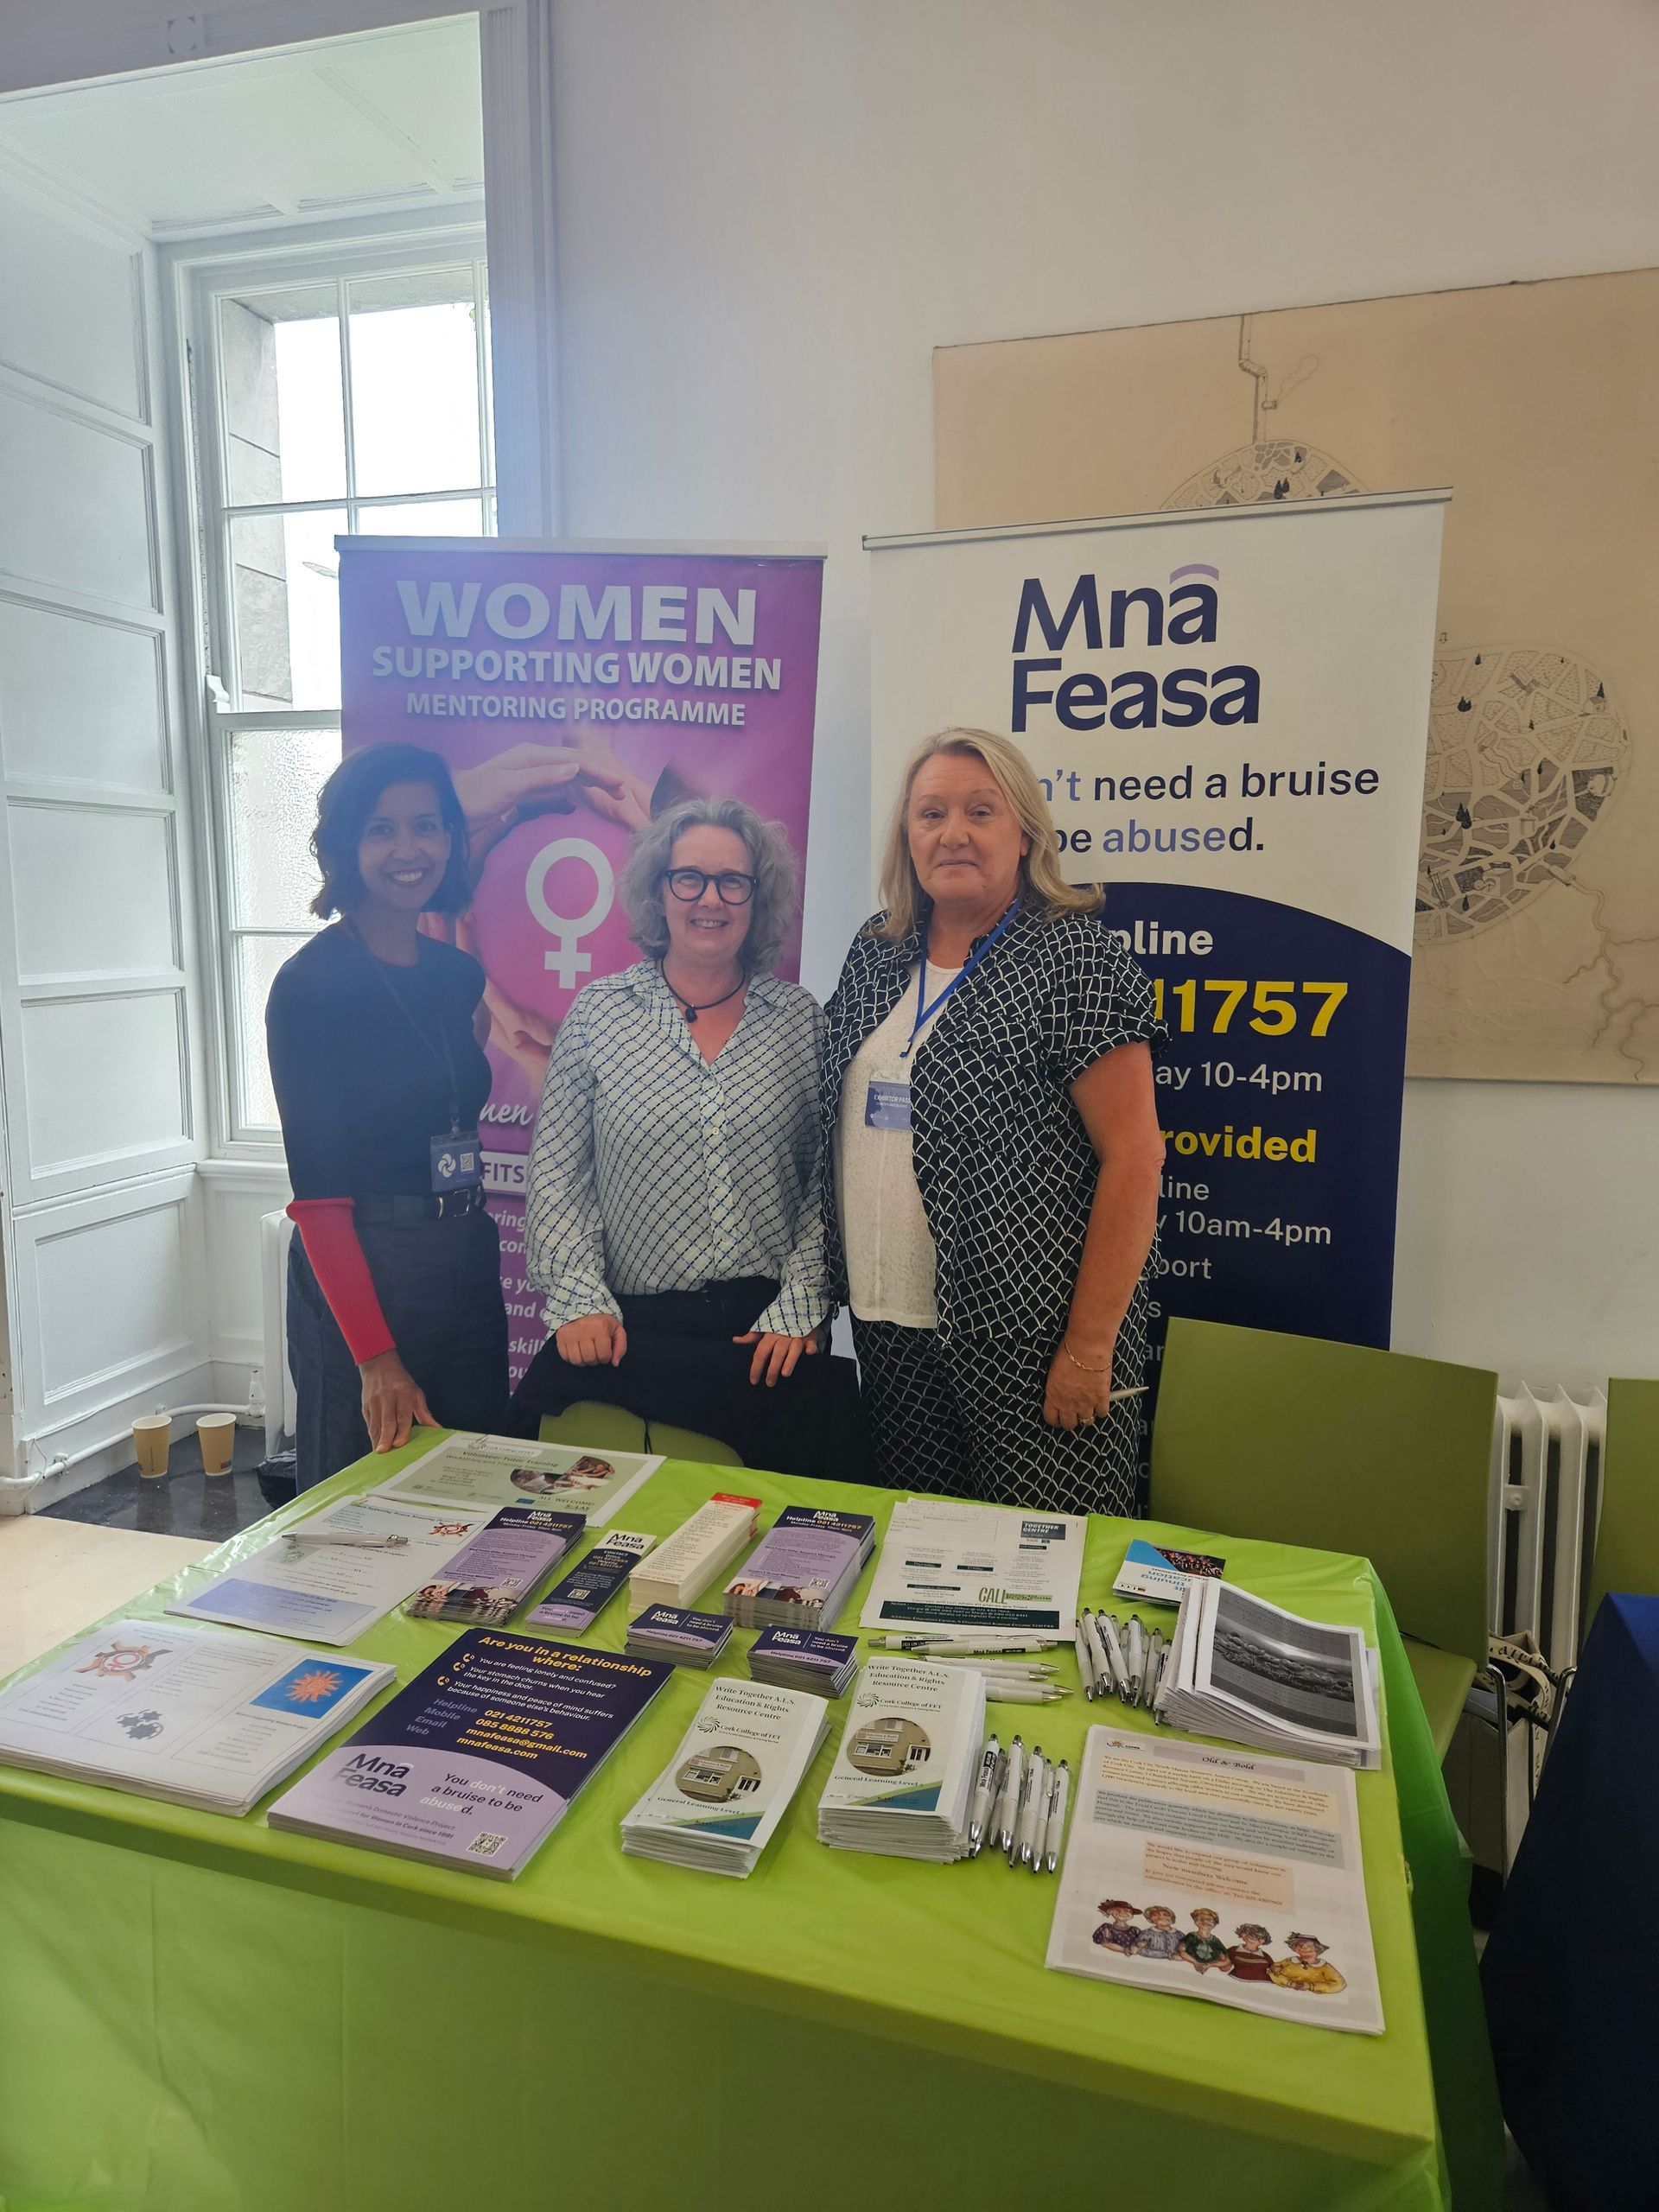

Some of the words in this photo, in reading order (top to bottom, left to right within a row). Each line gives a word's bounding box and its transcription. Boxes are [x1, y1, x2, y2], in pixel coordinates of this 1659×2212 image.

[397, 581, 756, 645] WOMEN
[372, 645, 620, 683] SUPPORTING
[628, 652, 781, 690] WOMEN
[407, 693, 566, 719] MENTORING
[574, 698, 745, 726] PROGRAMME
[1011, 658, 1260, 733] Feasa
[1095, 766, 1192, 800] need
[1205, 772, 1226, 798] a
[1242, 761, 1379, 798] bruise
[1103, 817, 1263, 852] abused.
[1109, 920, 1213, 956] pline
[1154, 978, 1348, 1037] 11757
[1201, 1062, 1322, 1095] 10-4pm
[1160, 1125, 1316, 1162] rovided
[482, 1162, 524, 1183] FITS
[1159, 1175, 1210, 1200] line
[1176, 1211, 1332, 1246] 10am-4pm
[979, 1587, 1007, 1604] CALL
[479, 1637, 505, 1647] Are
[505, 1642, 534, 1653] you
[535, 1646, 550, 1656] in
[562, 1653, 652, 1677] relationship
[532, 1656, 582, 1671] where:
[891, 1665, 927, 1675] Together
[487, 1670, 520, 1681] stomach
[520, 1675, 547, 1687] churns
[586, 1690, 606, 1699] hear
[507, 1662, 535, 1674] feeling
[535, 1669, 558, 1678] lonely
[575, 1677, 616, 1689] confused?
[514, 1680, 533, 1690] door.
[448, 1686, 480, 1697] because
[490, 1695, 525, 1707] someone
[549, 1707, 590, 1720] behaviour.
[472, 1684, 512, 1698] happiness
[528, 1697, 552, 1706] peace
[584, 1707, 613, 1719] suffers
[715, 1694, 755, 1707] Education
[764, 1703, 789, 1713] Rights
[739, 1689, 773, 1700] Together
[424, 1707, 461, 1720] Mobile
[475, 1719, 499, 1728] 085
[499, 1723, 531, 1735] 8888
[530, 1730, 554, 1739] 576
[433, 1699, 478, 1713] Helpline
[484, 1710, 505, 1719] 021
[505, 1714, 552, 1728] 4211757
[716, 1704, 753, 1715] Resource
[753, 1711, 780, 1719] Centre
[406, 1724, 429, 1735] Web
[456, 1737, 538, 1759] mnafeasa.com
[415, 1715, 448, 1728] Email
[466, 1728, 588, 1759] mnafeasa@gmail.com
[736, 1727, 760, 1736] College
[330, 1767, 407, 1797] Feasa
[442, 1786, 486, 1802] bruise
[488, 1798, 502, 1807] to
[504, 1801, 523, 1812] be
[444, 1773, 468, 1785] You
[469, 1780, 505, 1794] don't
[506, 1789, 543, 1802] need
[419, 1796, 474, 1815] abused.
